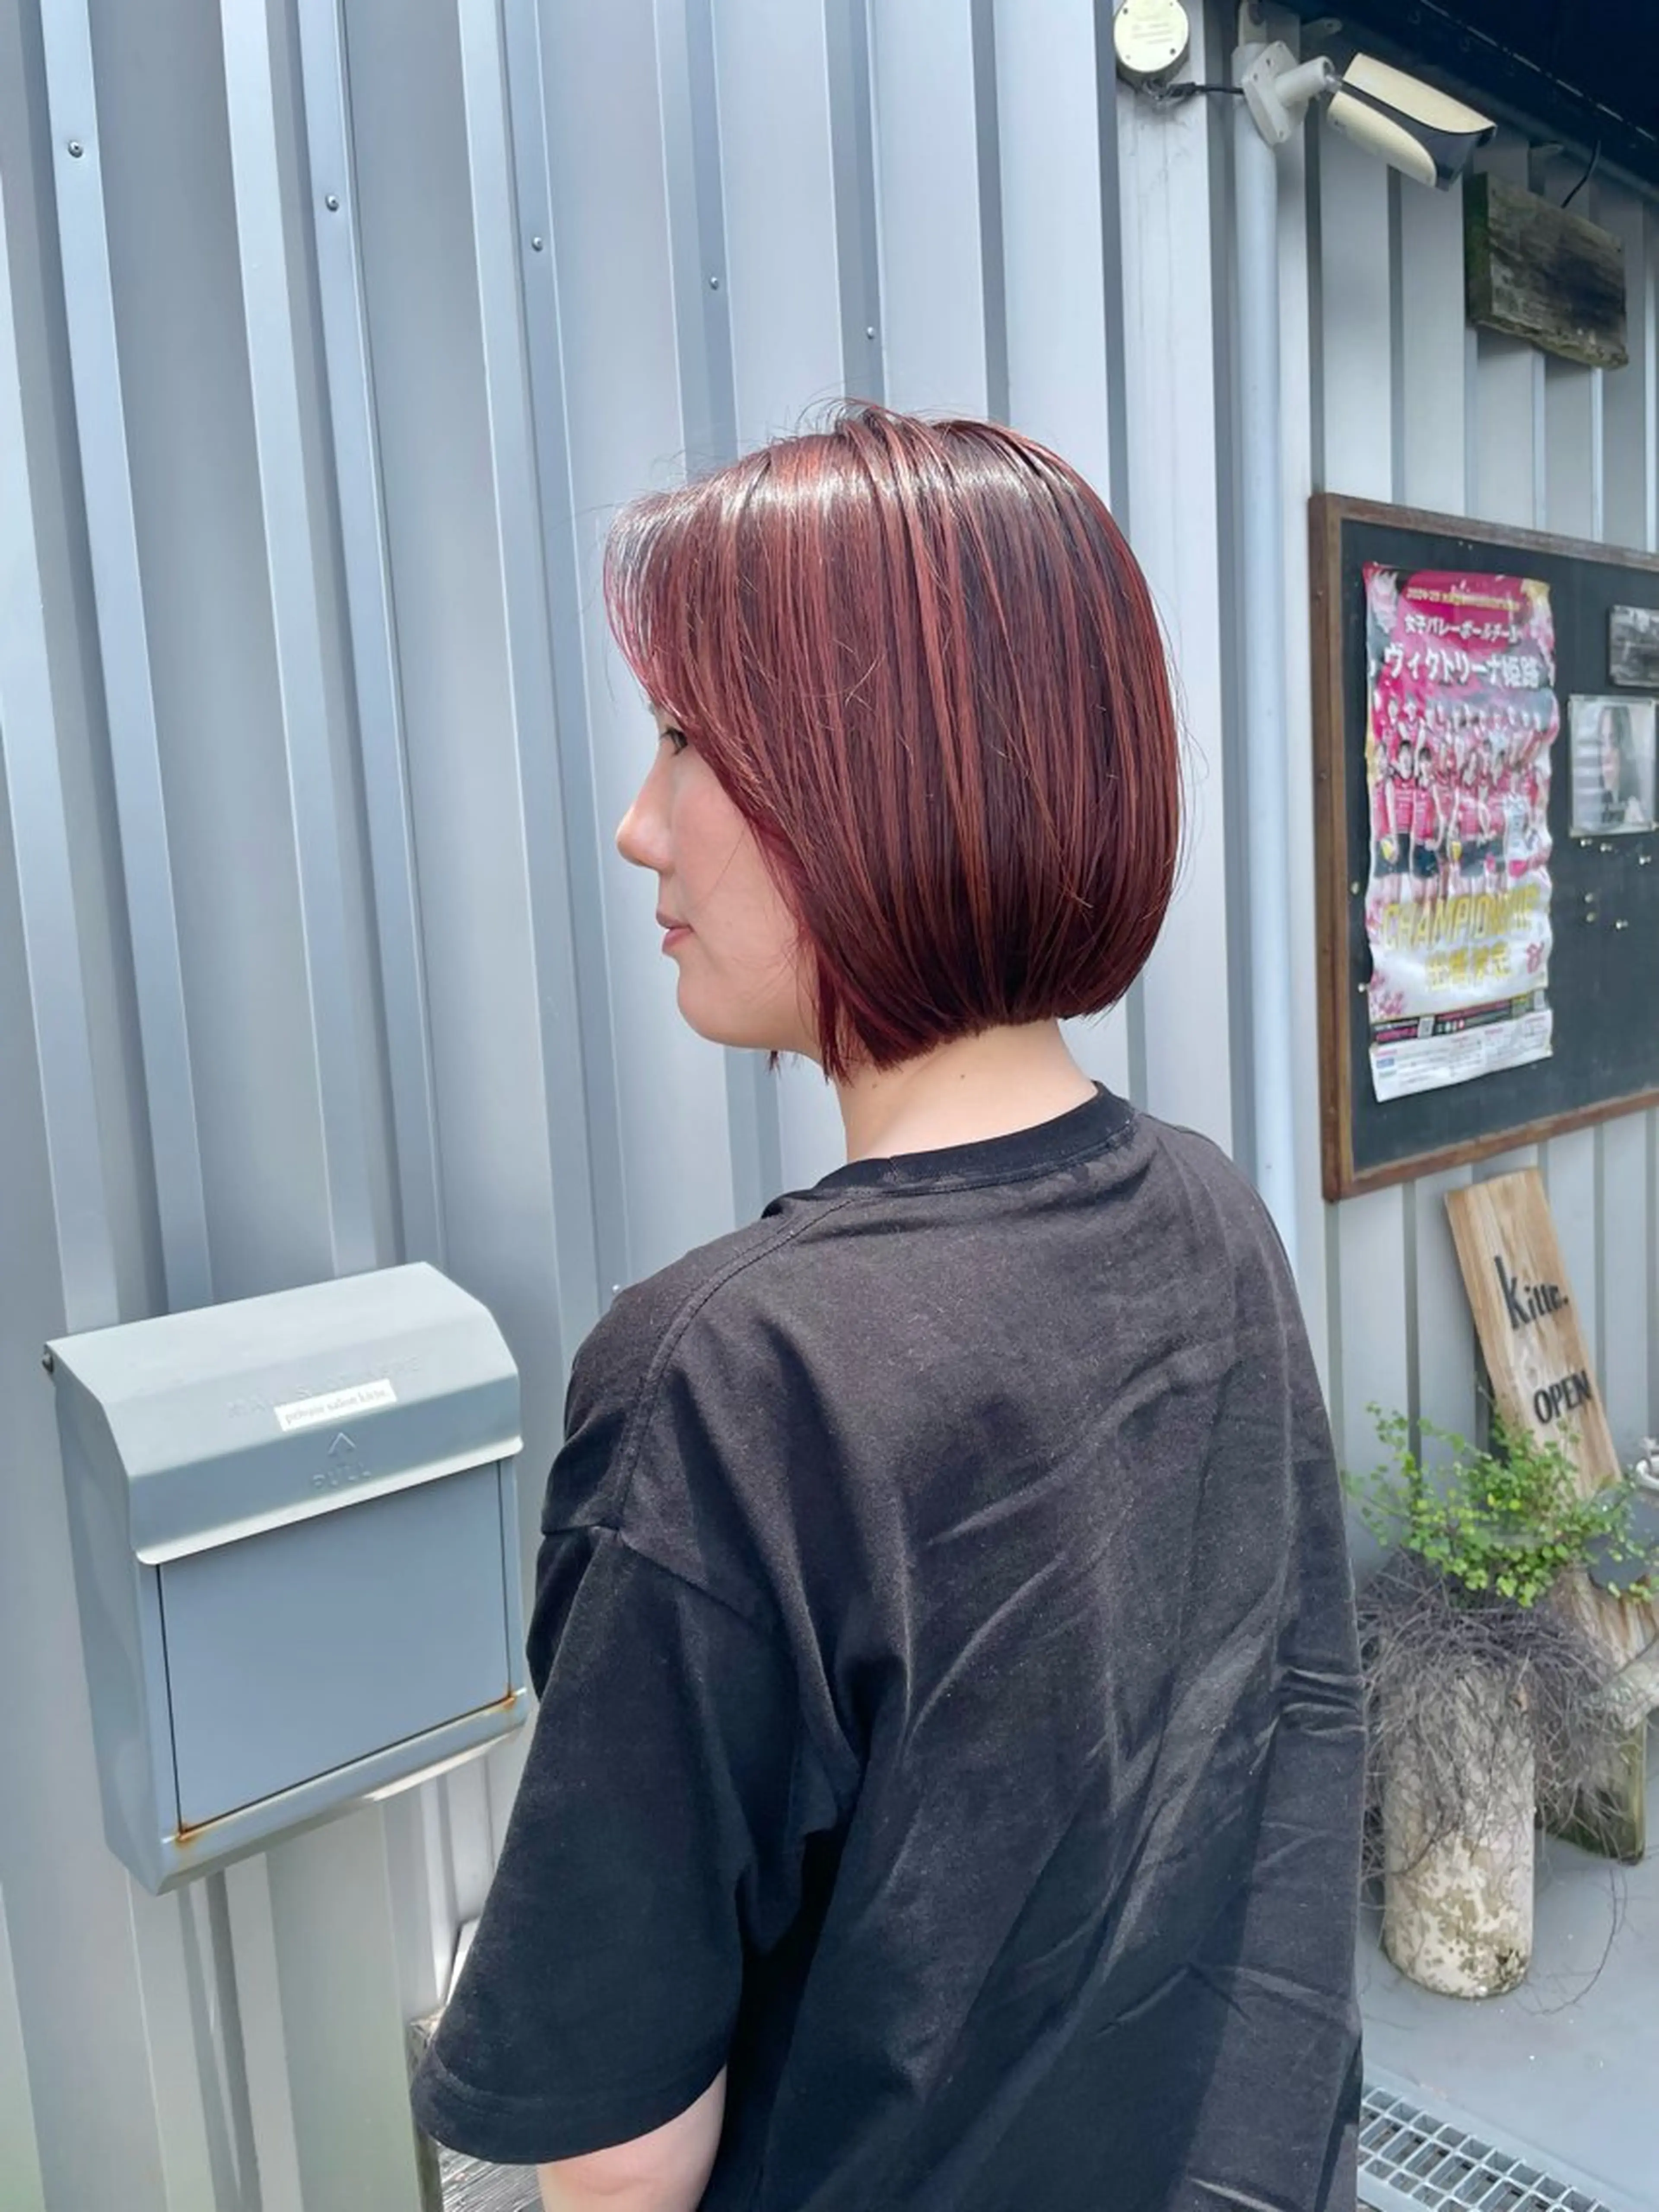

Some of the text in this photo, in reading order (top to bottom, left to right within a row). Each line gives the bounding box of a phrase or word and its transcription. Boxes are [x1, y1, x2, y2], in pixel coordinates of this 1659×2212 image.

[1384, 642, 1540, 688] ヴィクトリーナ姫路
[1382, 882, 1539, 952] CHAMPIONIP
[1534, 1370, 1592, 1424] OPEN
